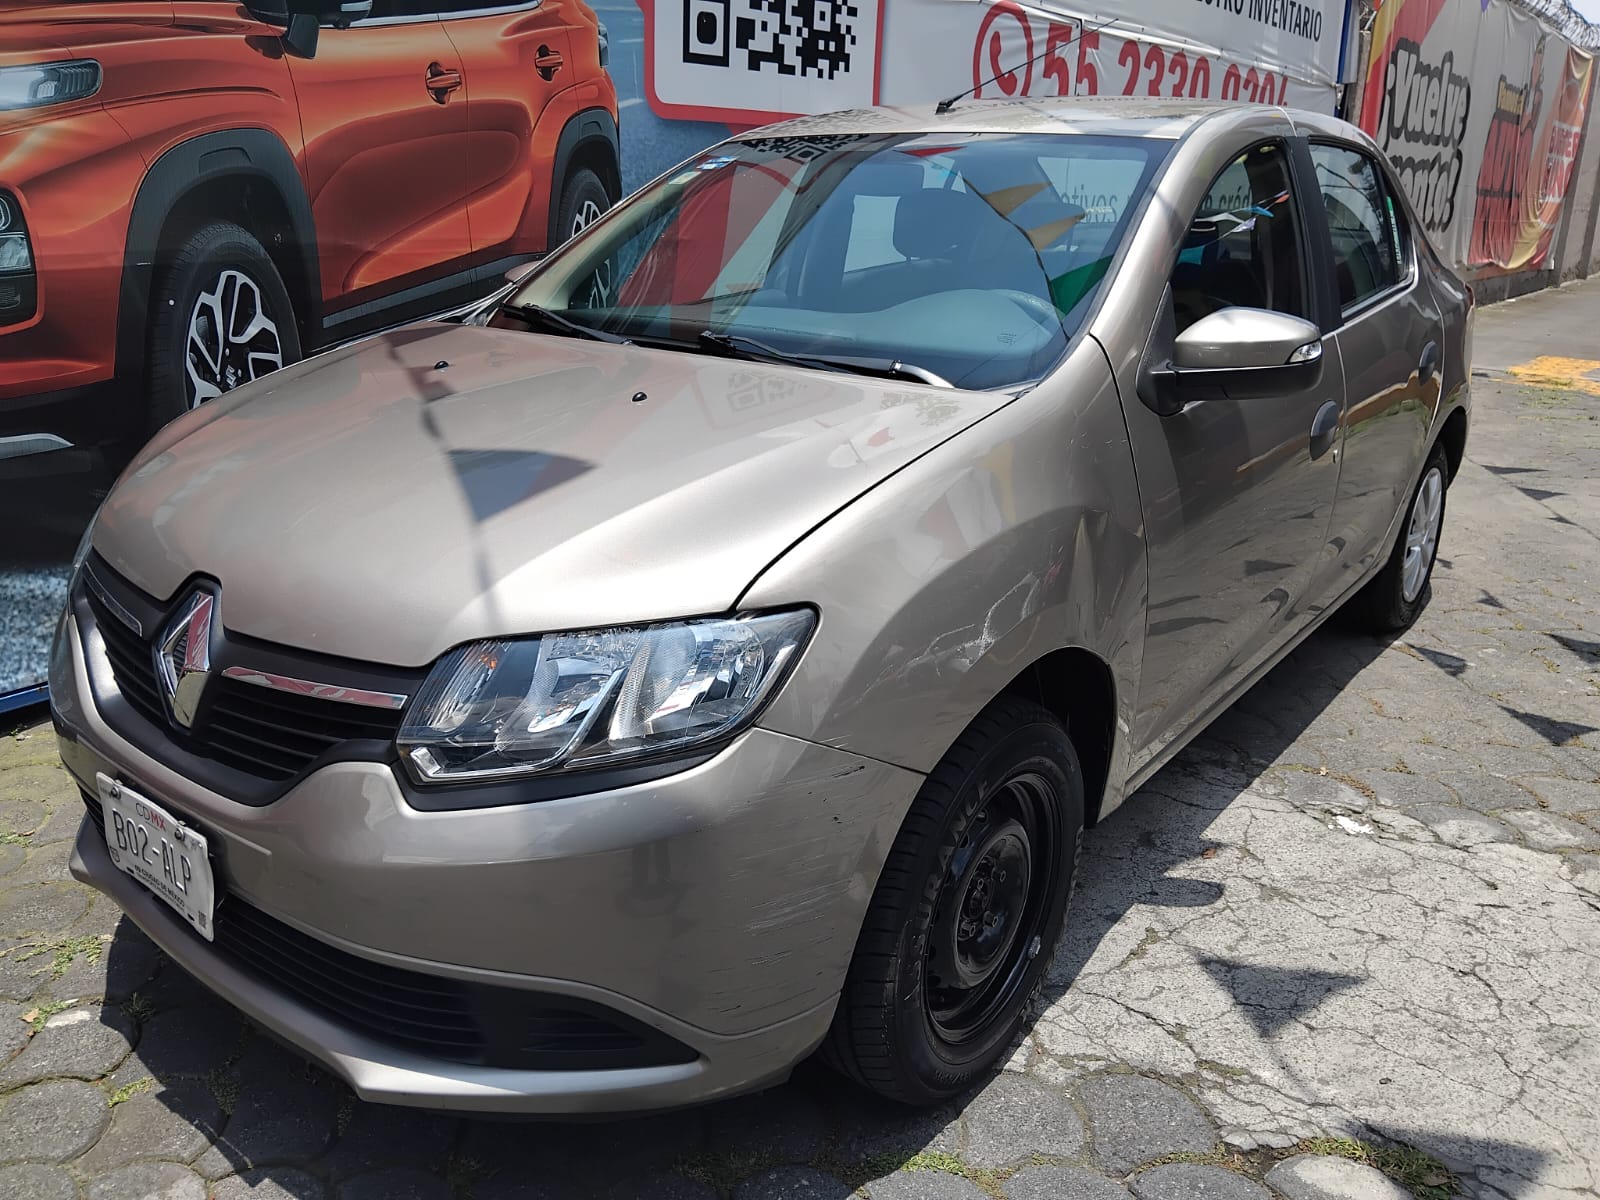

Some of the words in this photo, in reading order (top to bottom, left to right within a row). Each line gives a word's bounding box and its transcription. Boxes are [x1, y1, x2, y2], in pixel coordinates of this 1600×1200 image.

[1248, 0, 1322, 42] INVENTARIO
[1043, 22, 1099, 97] 55
[135, 802, 166, 832] CDMX
[112, 808, 191, 896] B02-ALP
